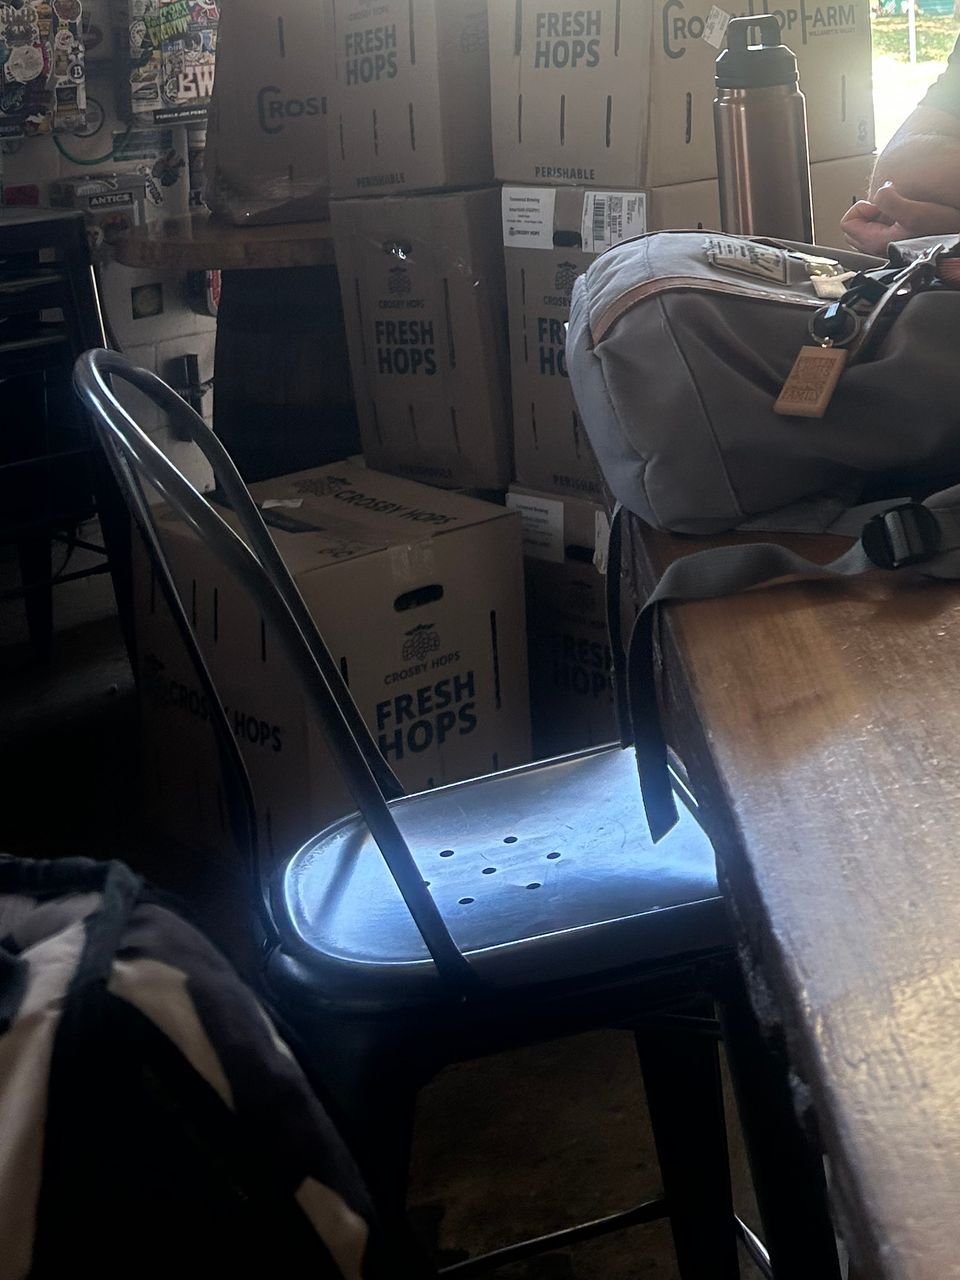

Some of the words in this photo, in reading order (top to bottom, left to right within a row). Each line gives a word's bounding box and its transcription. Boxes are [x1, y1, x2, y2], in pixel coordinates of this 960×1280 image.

[536, 10, 602, 38] FRESH
[344, 23, 397, 57] FRESH
[534, 38, 601, 69] HOPS
[345, 51, 398, 86] HOPS
[356, 172, 406, 189] PERISHABLE
[535, 165, 595, 181] PERISHABLE
[90, 195, 130, 207] ANTICS
[378, 299, 405, 309] CROSBY
[406, 299, 425, 309] HOPS
[375, 320, 434, 346] FRESH
[377, 347, 437, 376] HOPS
[334, 489, 405, 515] CROSBY
[400, 508, 457, 525] HOPS
[384, 663, 428, 686] CROSBY
[431, 650, 462, 670] HOPS
[376, 670, 476, 732] FRESH
[234, 709, 283, 753] HOPS
[378, 701, 477, 761] HOPS
